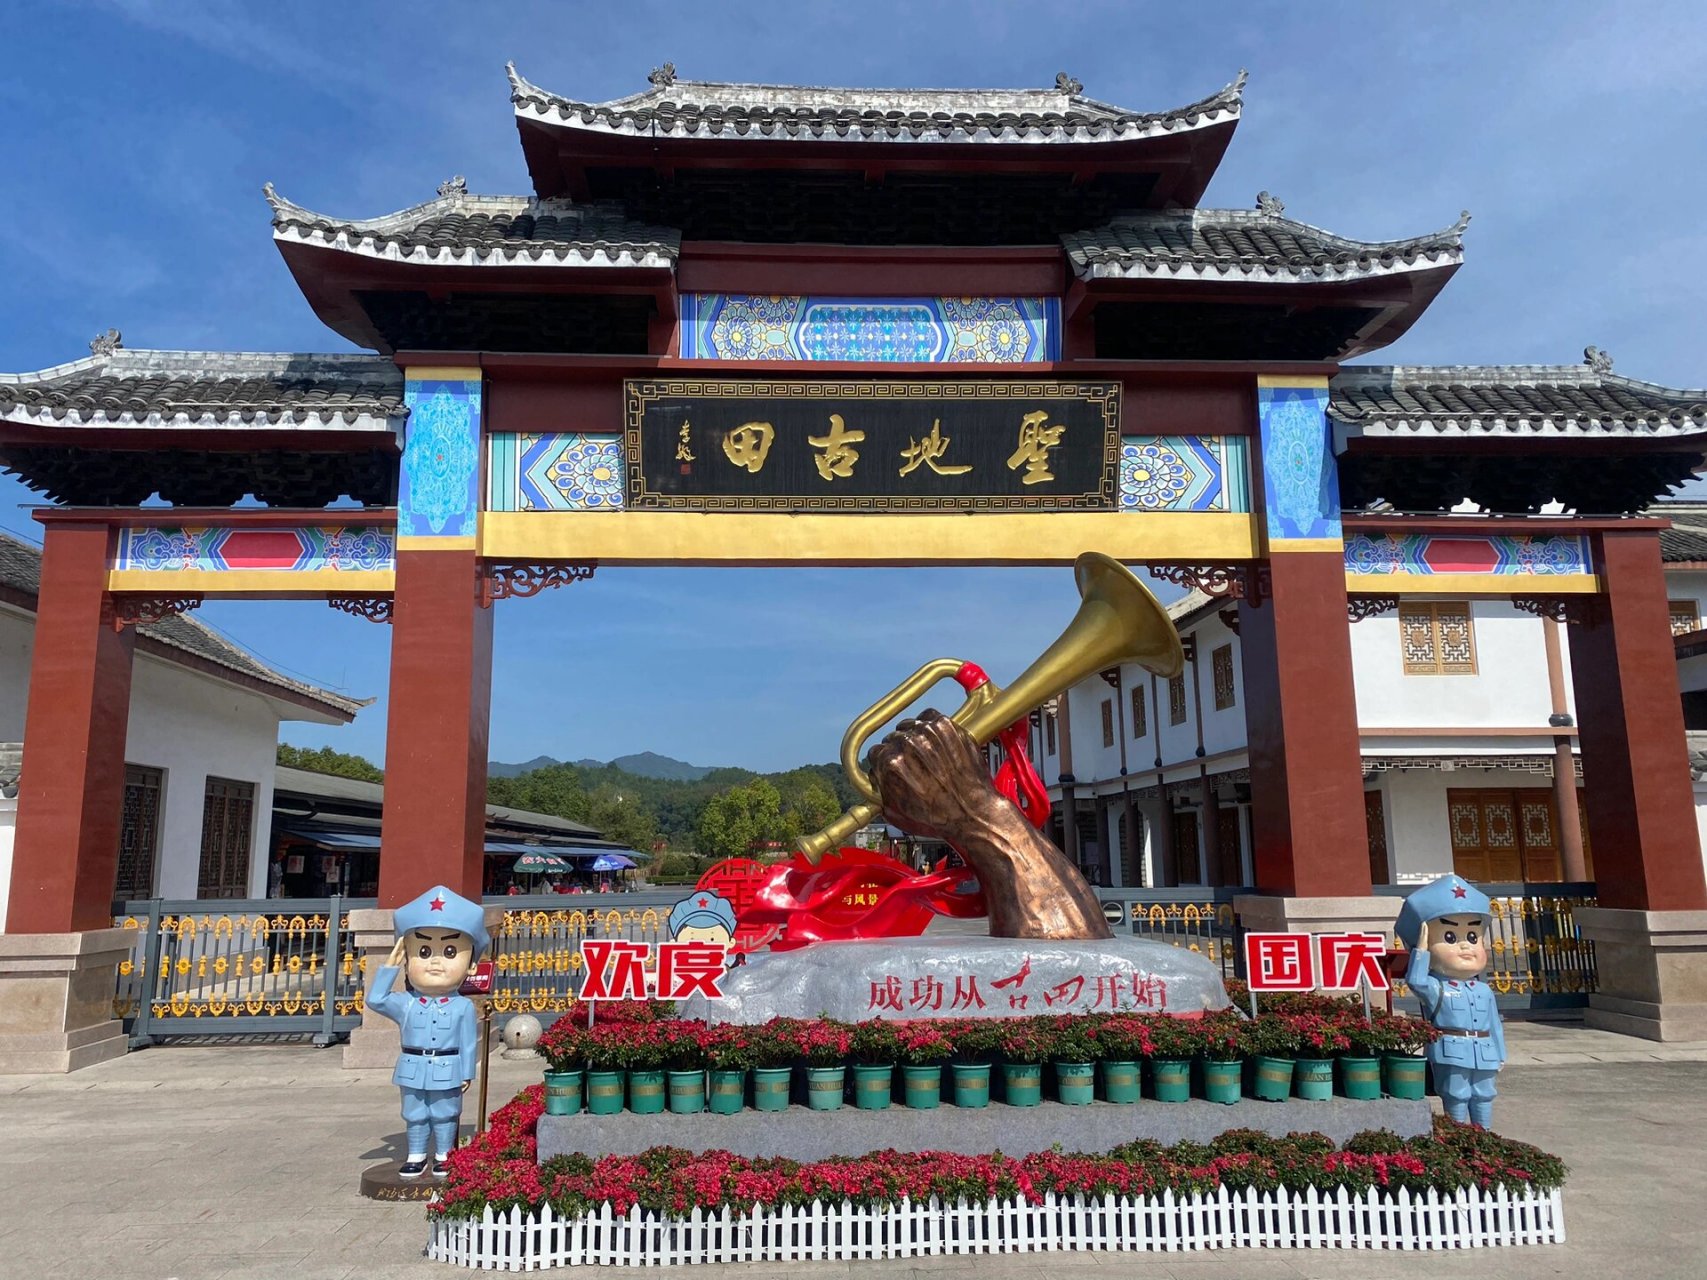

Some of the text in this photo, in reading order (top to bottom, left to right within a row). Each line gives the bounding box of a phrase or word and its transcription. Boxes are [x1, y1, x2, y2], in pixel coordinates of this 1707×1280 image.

[579, 940, 726, 1000] 欢度
[868, 954, 1168, 1013] 成功从古田开始
[1245, 932, 1390, 993] 国庆
